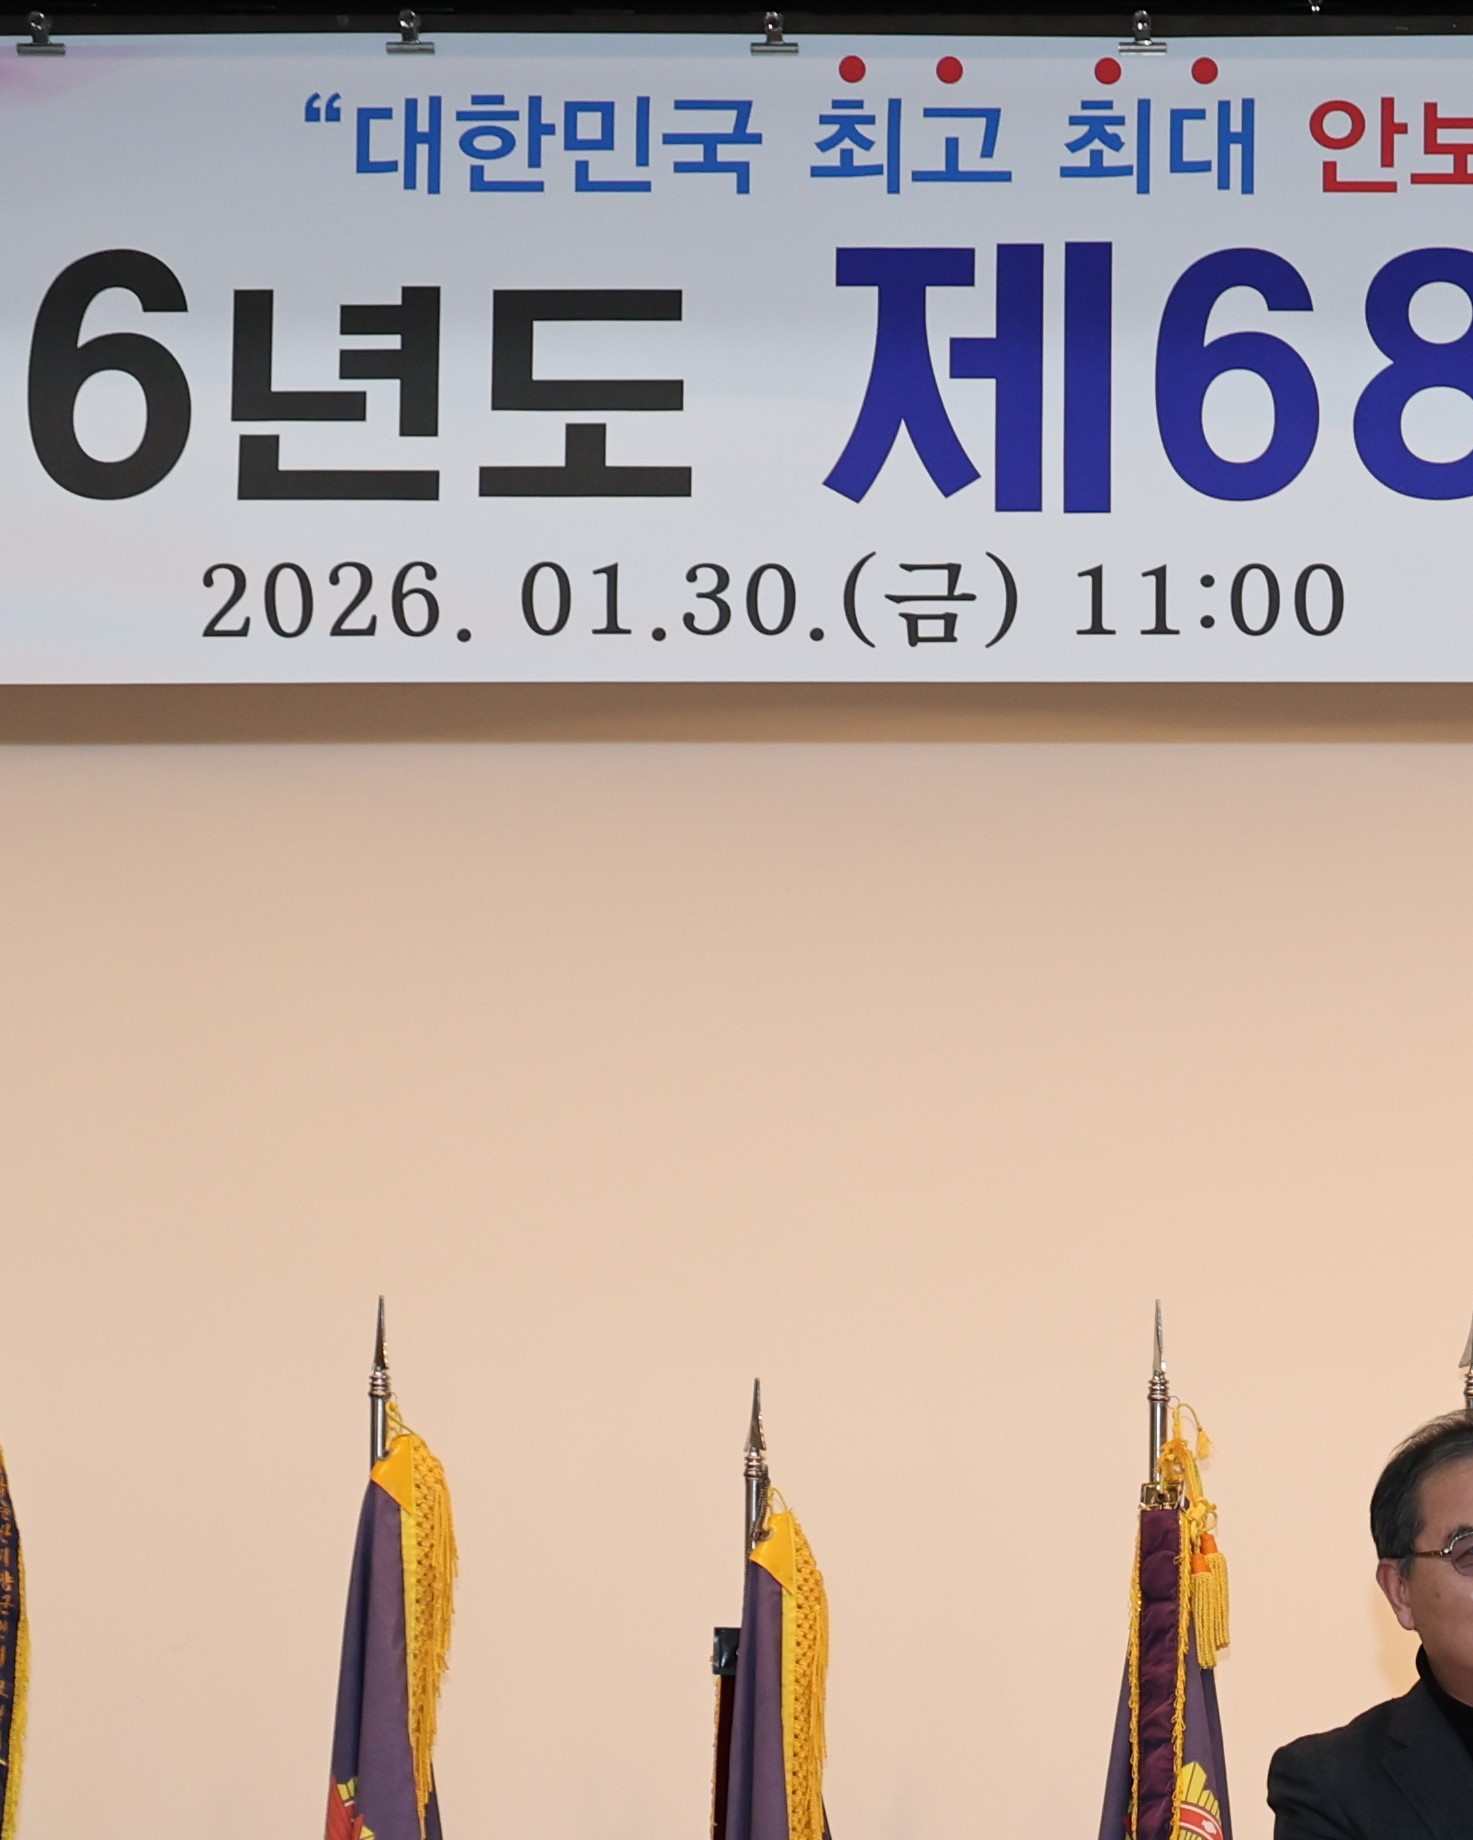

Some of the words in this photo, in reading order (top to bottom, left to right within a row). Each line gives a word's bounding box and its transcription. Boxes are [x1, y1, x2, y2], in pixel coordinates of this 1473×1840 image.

[809, 97, 1013, 195] 최고
[1059, 97, 1255, 195] 최대
[202, 560, 472, 643] 2026.
[521, 551, 1018, 648] 01.30.(금)
[1076, 562, 1345, 637] 11:00
